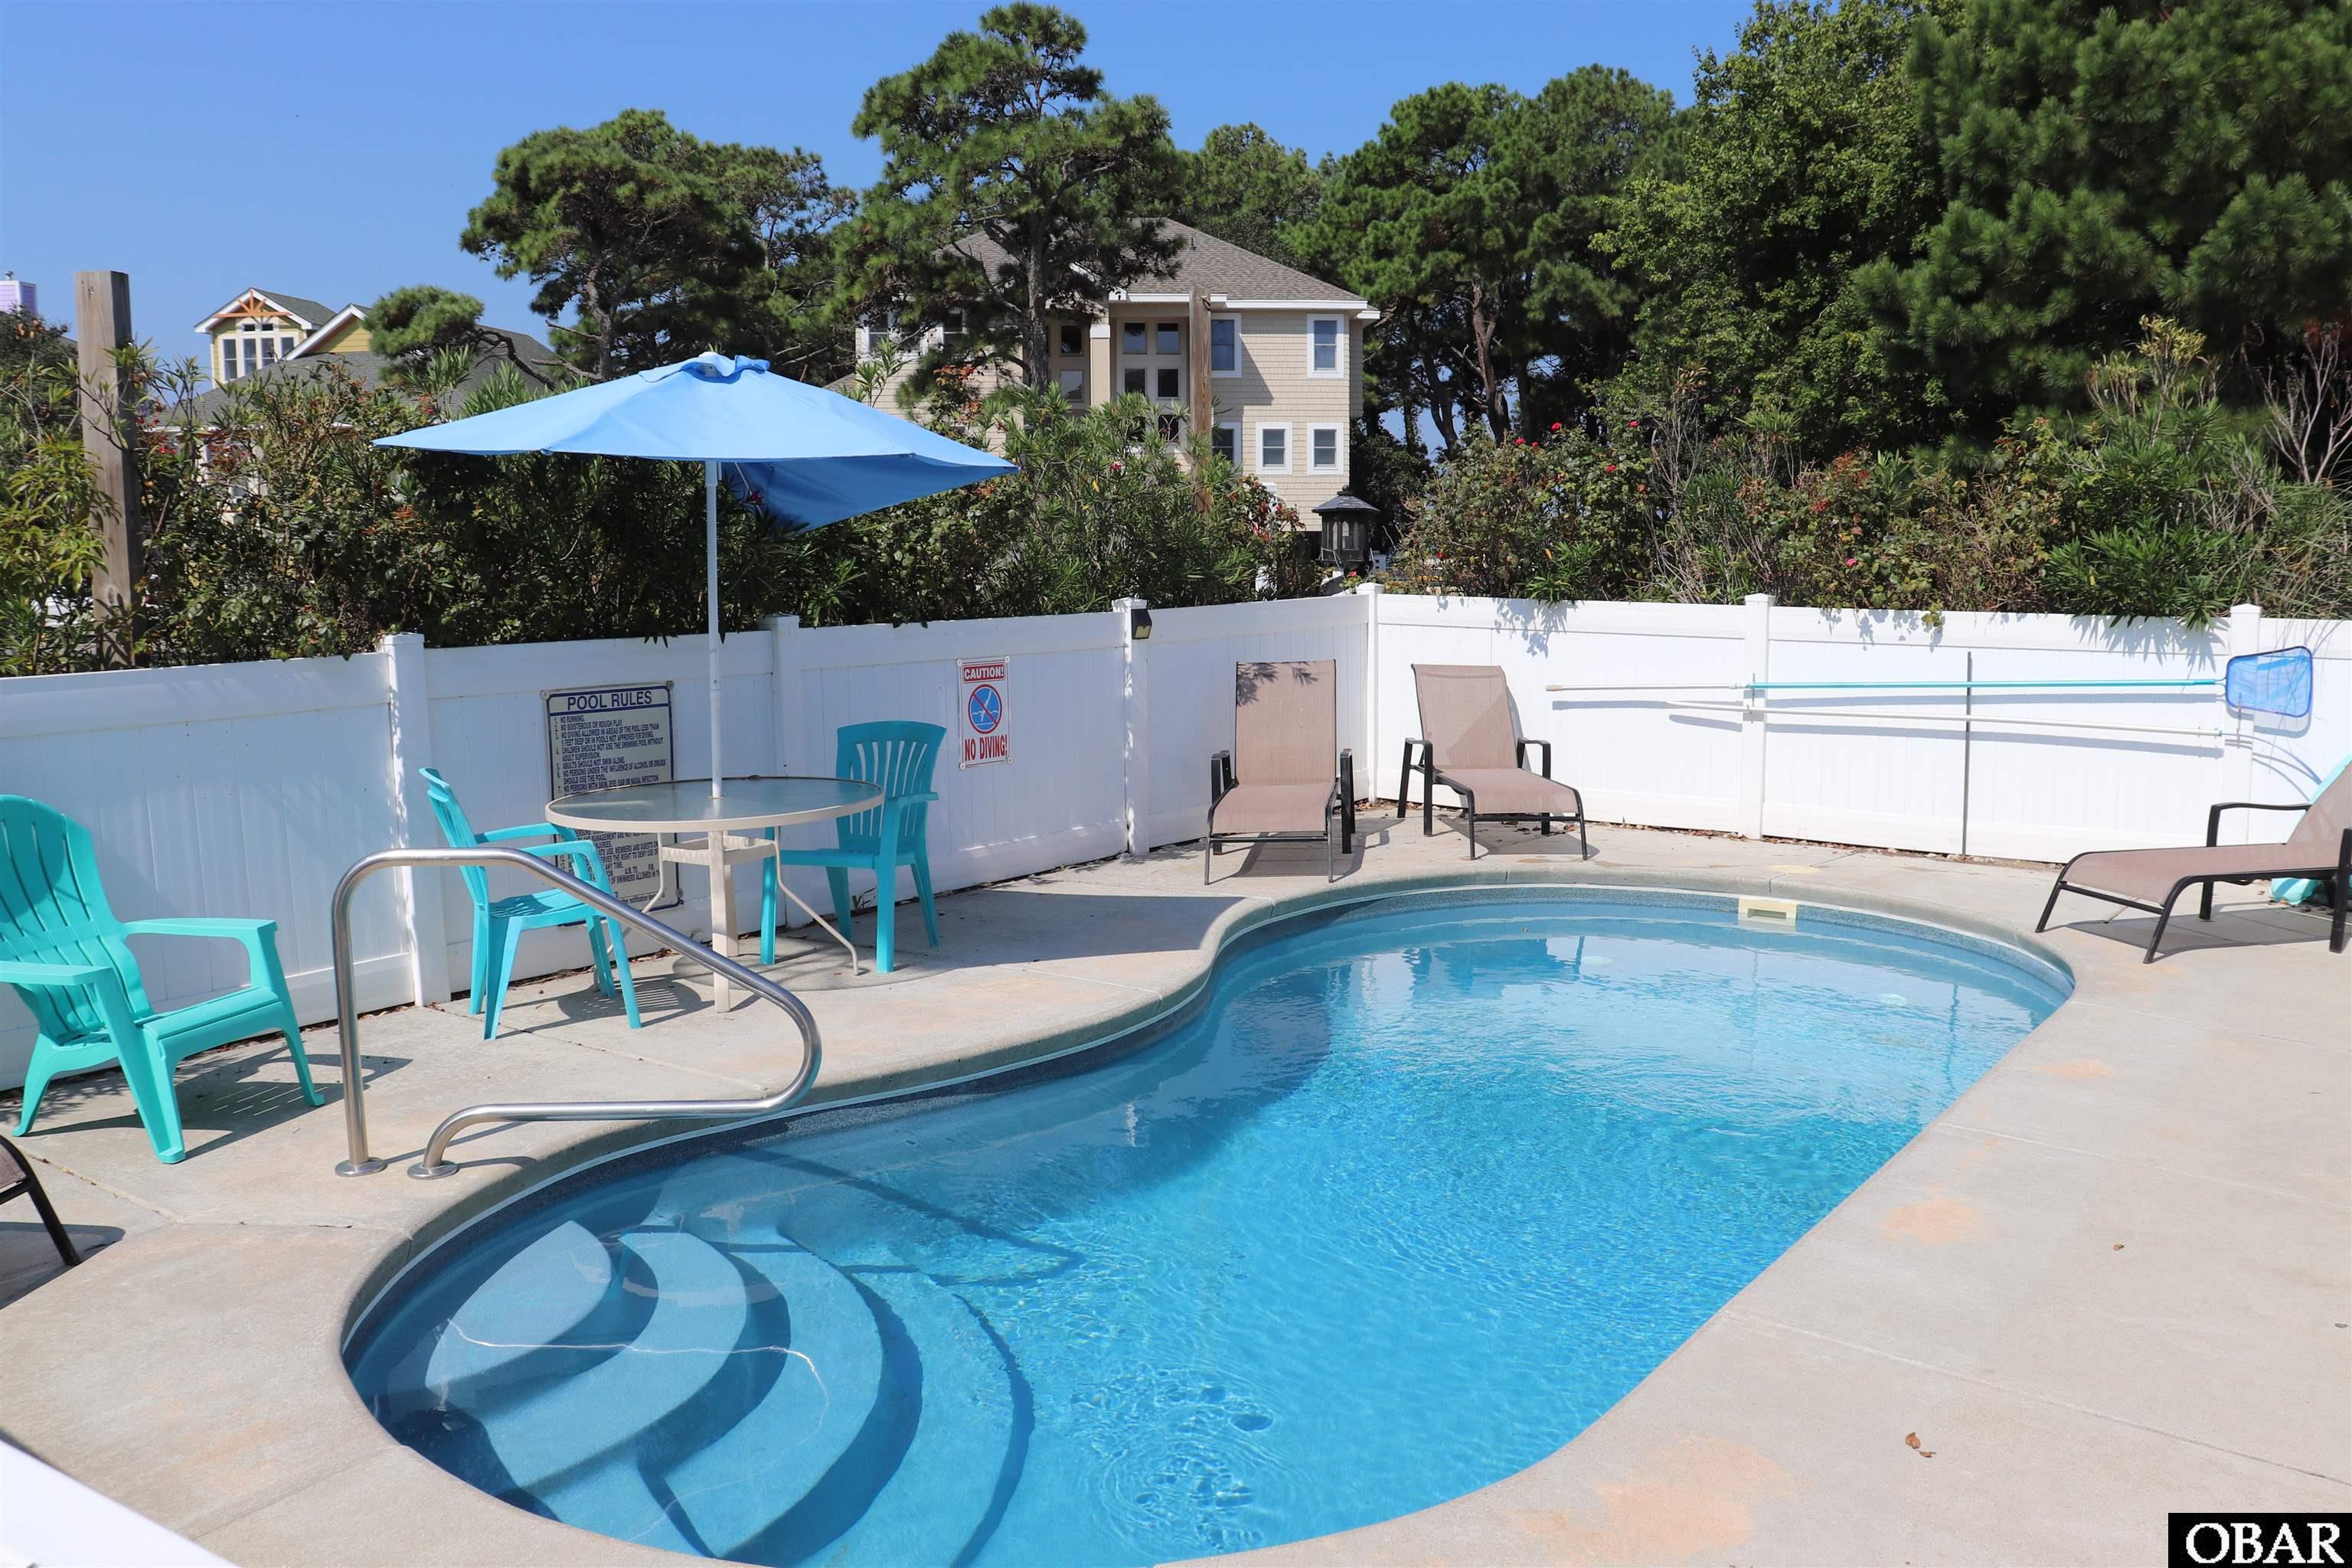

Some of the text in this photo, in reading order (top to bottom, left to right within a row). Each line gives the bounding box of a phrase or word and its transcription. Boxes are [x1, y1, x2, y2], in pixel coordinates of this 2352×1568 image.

[964, 666, 1004, 680] CAUTION!
[567, 691, 652, 710] POOL RULES
[567, 722, 591, 730] BOISTEROUS
[582, 728, 600, 737] ALLOWED
[606, 727, 618, 735] AREAS
[618, 733, 634, 741] APPROVED
[562, 746, 580, 754] CHILDREN
[622, 740, 639, 749] SWIMMING
[648, 737, 663, 746] WITHOUT
[965, 734, 1008, 761] NO DIVING!
[563, 752, 600, 762] ADULT SUPERVISION.
[563, 761, 577, 769] ADULTS
[577, 760, 593, 768] SHOULD
[569, 768, 586, 776] PERSONS
[587, 766, 600, 775] UNDER
[609, 763, 629, 773] INFLUENCE
[634, 761, 648, 769] ALCOHOL
[654, 759, 666, 767] DRUGS
[570, 783, 587, 792] PERSONS
[592, 833, 616, 841] MANAGEMENT
[615, 845, 632, 854] MEMBERS
[641, 841, 653, 850] GUESTS
[621, 852, 632, 861] RIGHT
[616, 874, 635, 883] SWIMMERS
[636, 871, 651, 880] ALLOWED
